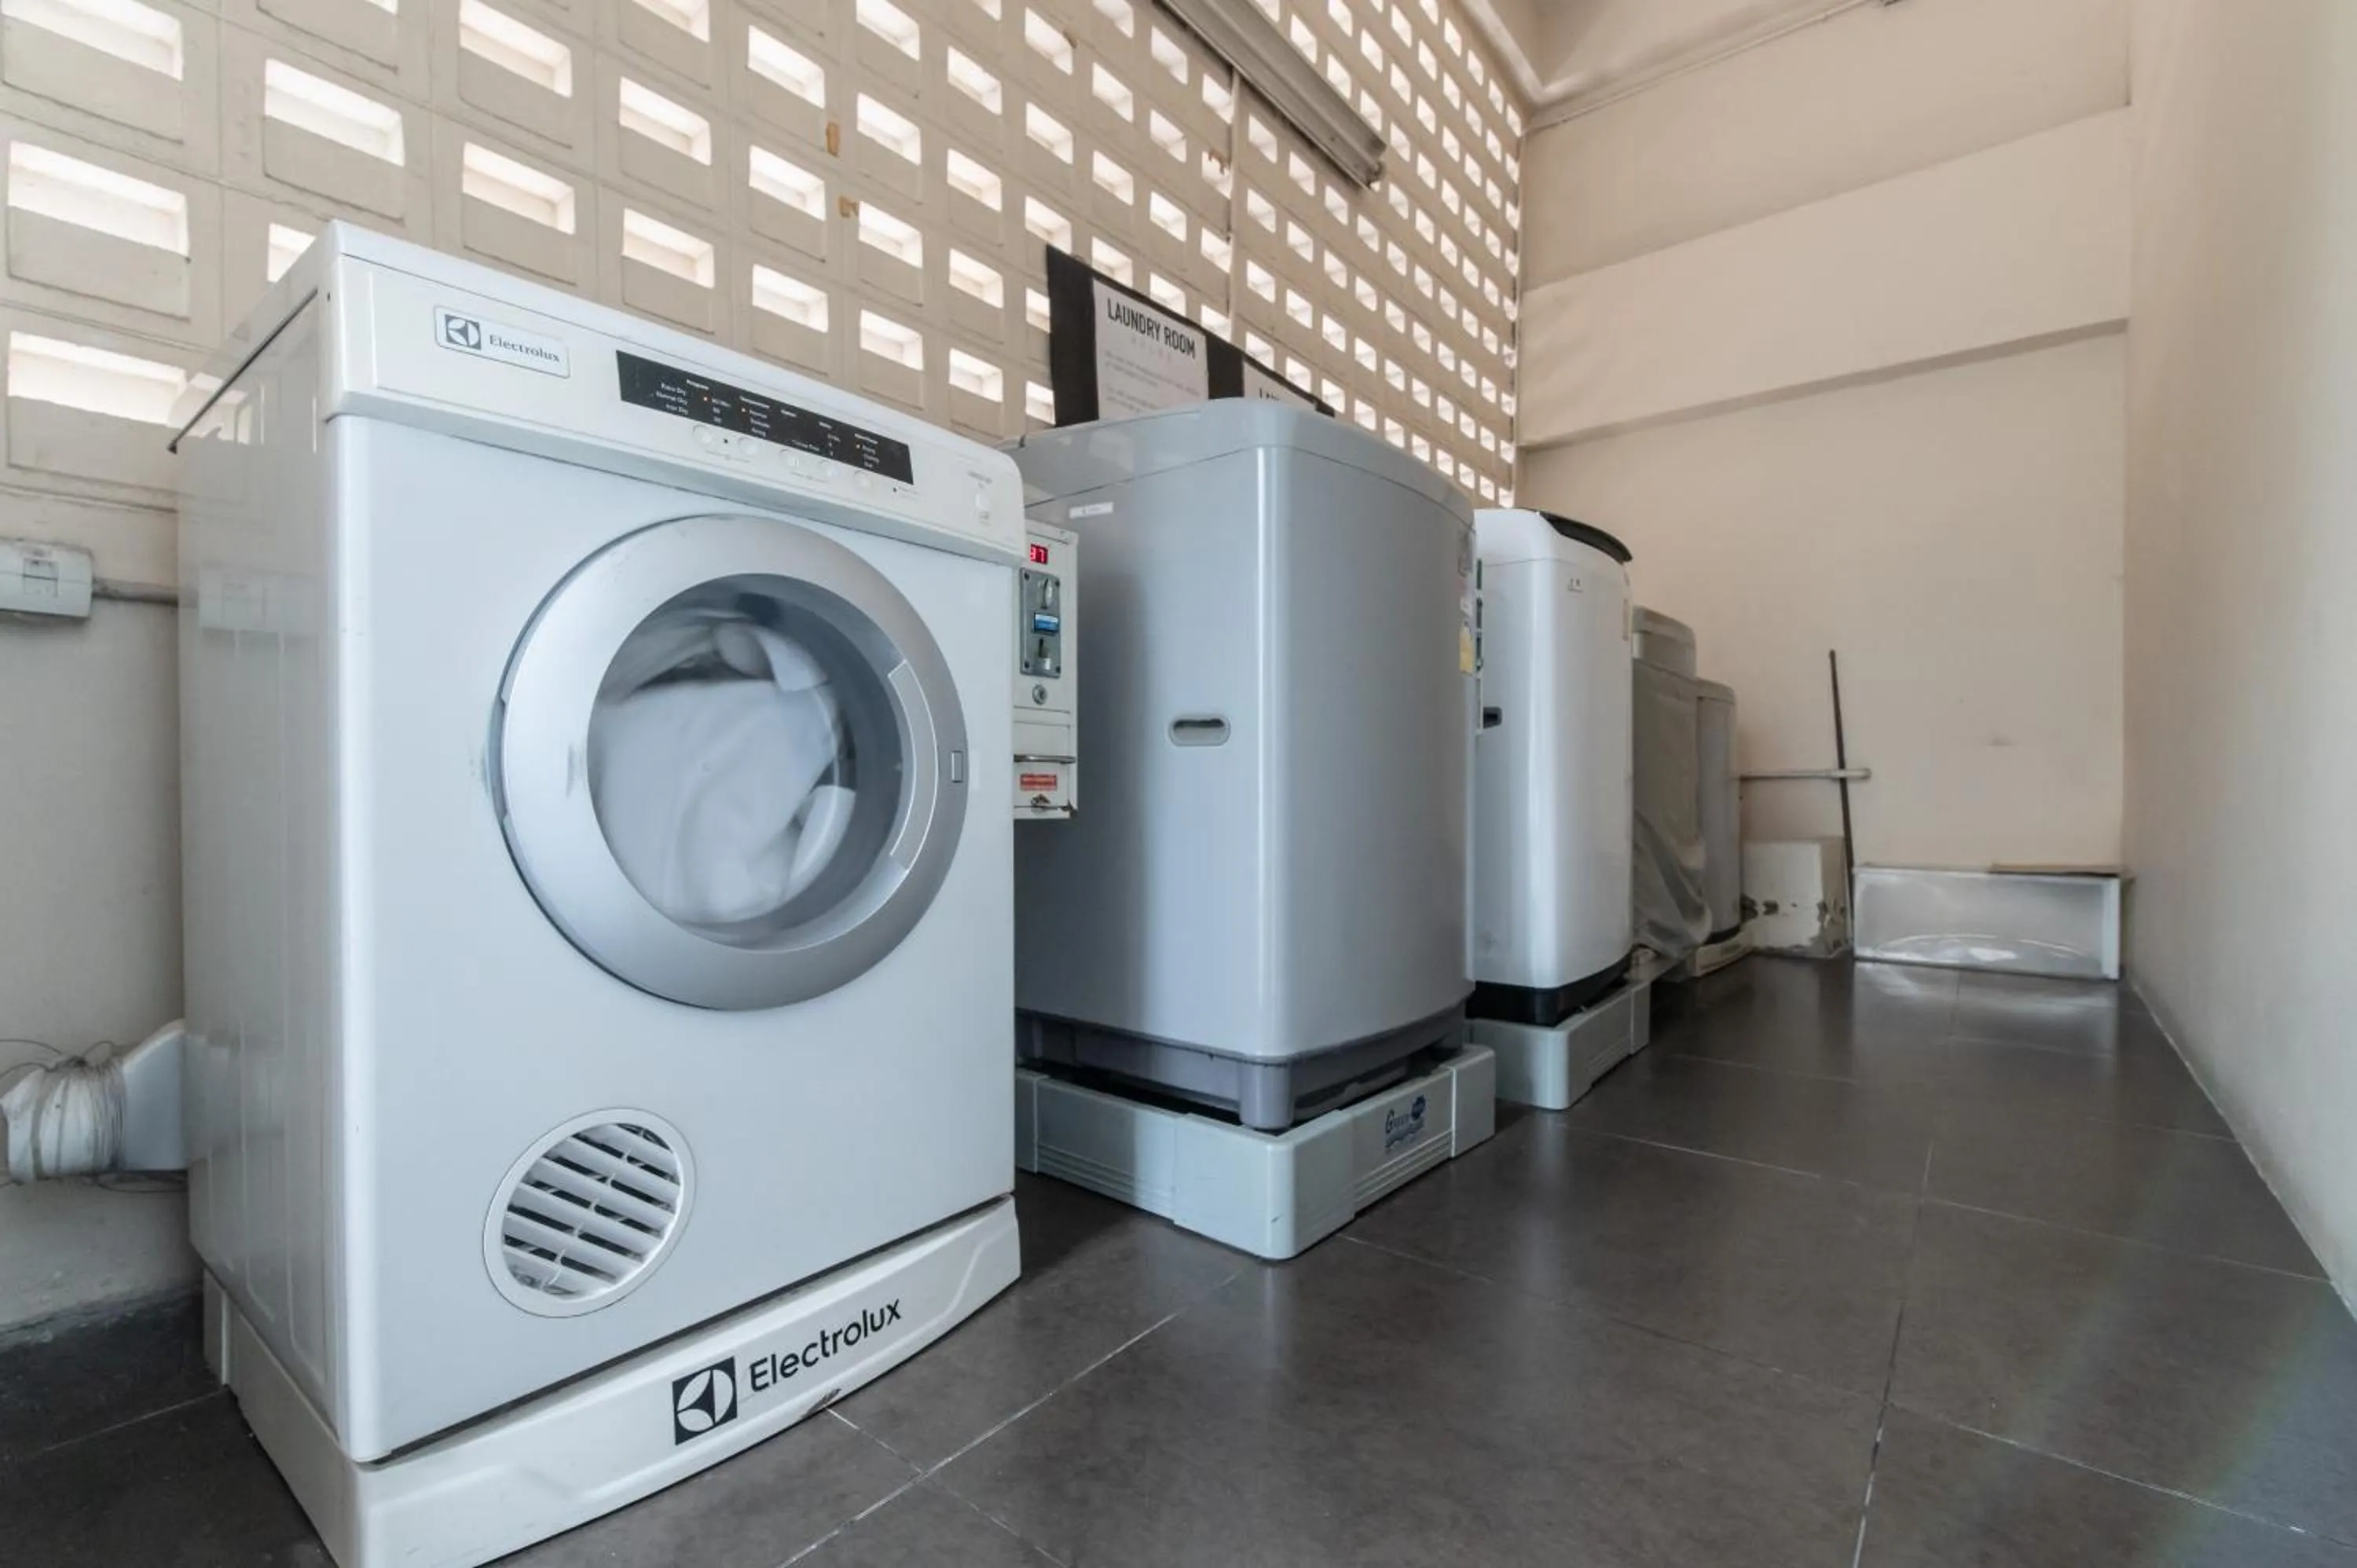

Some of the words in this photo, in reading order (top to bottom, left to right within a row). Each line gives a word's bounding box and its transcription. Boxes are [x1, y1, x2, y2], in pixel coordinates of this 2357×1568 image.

[489, 334, 559, 363] Electrolux
[1107, 297, 1160, 341] LAUNDRY
[1164, 326, 1195, 359] ROOM
[750, 1299, 901, 1393] Electrolux
